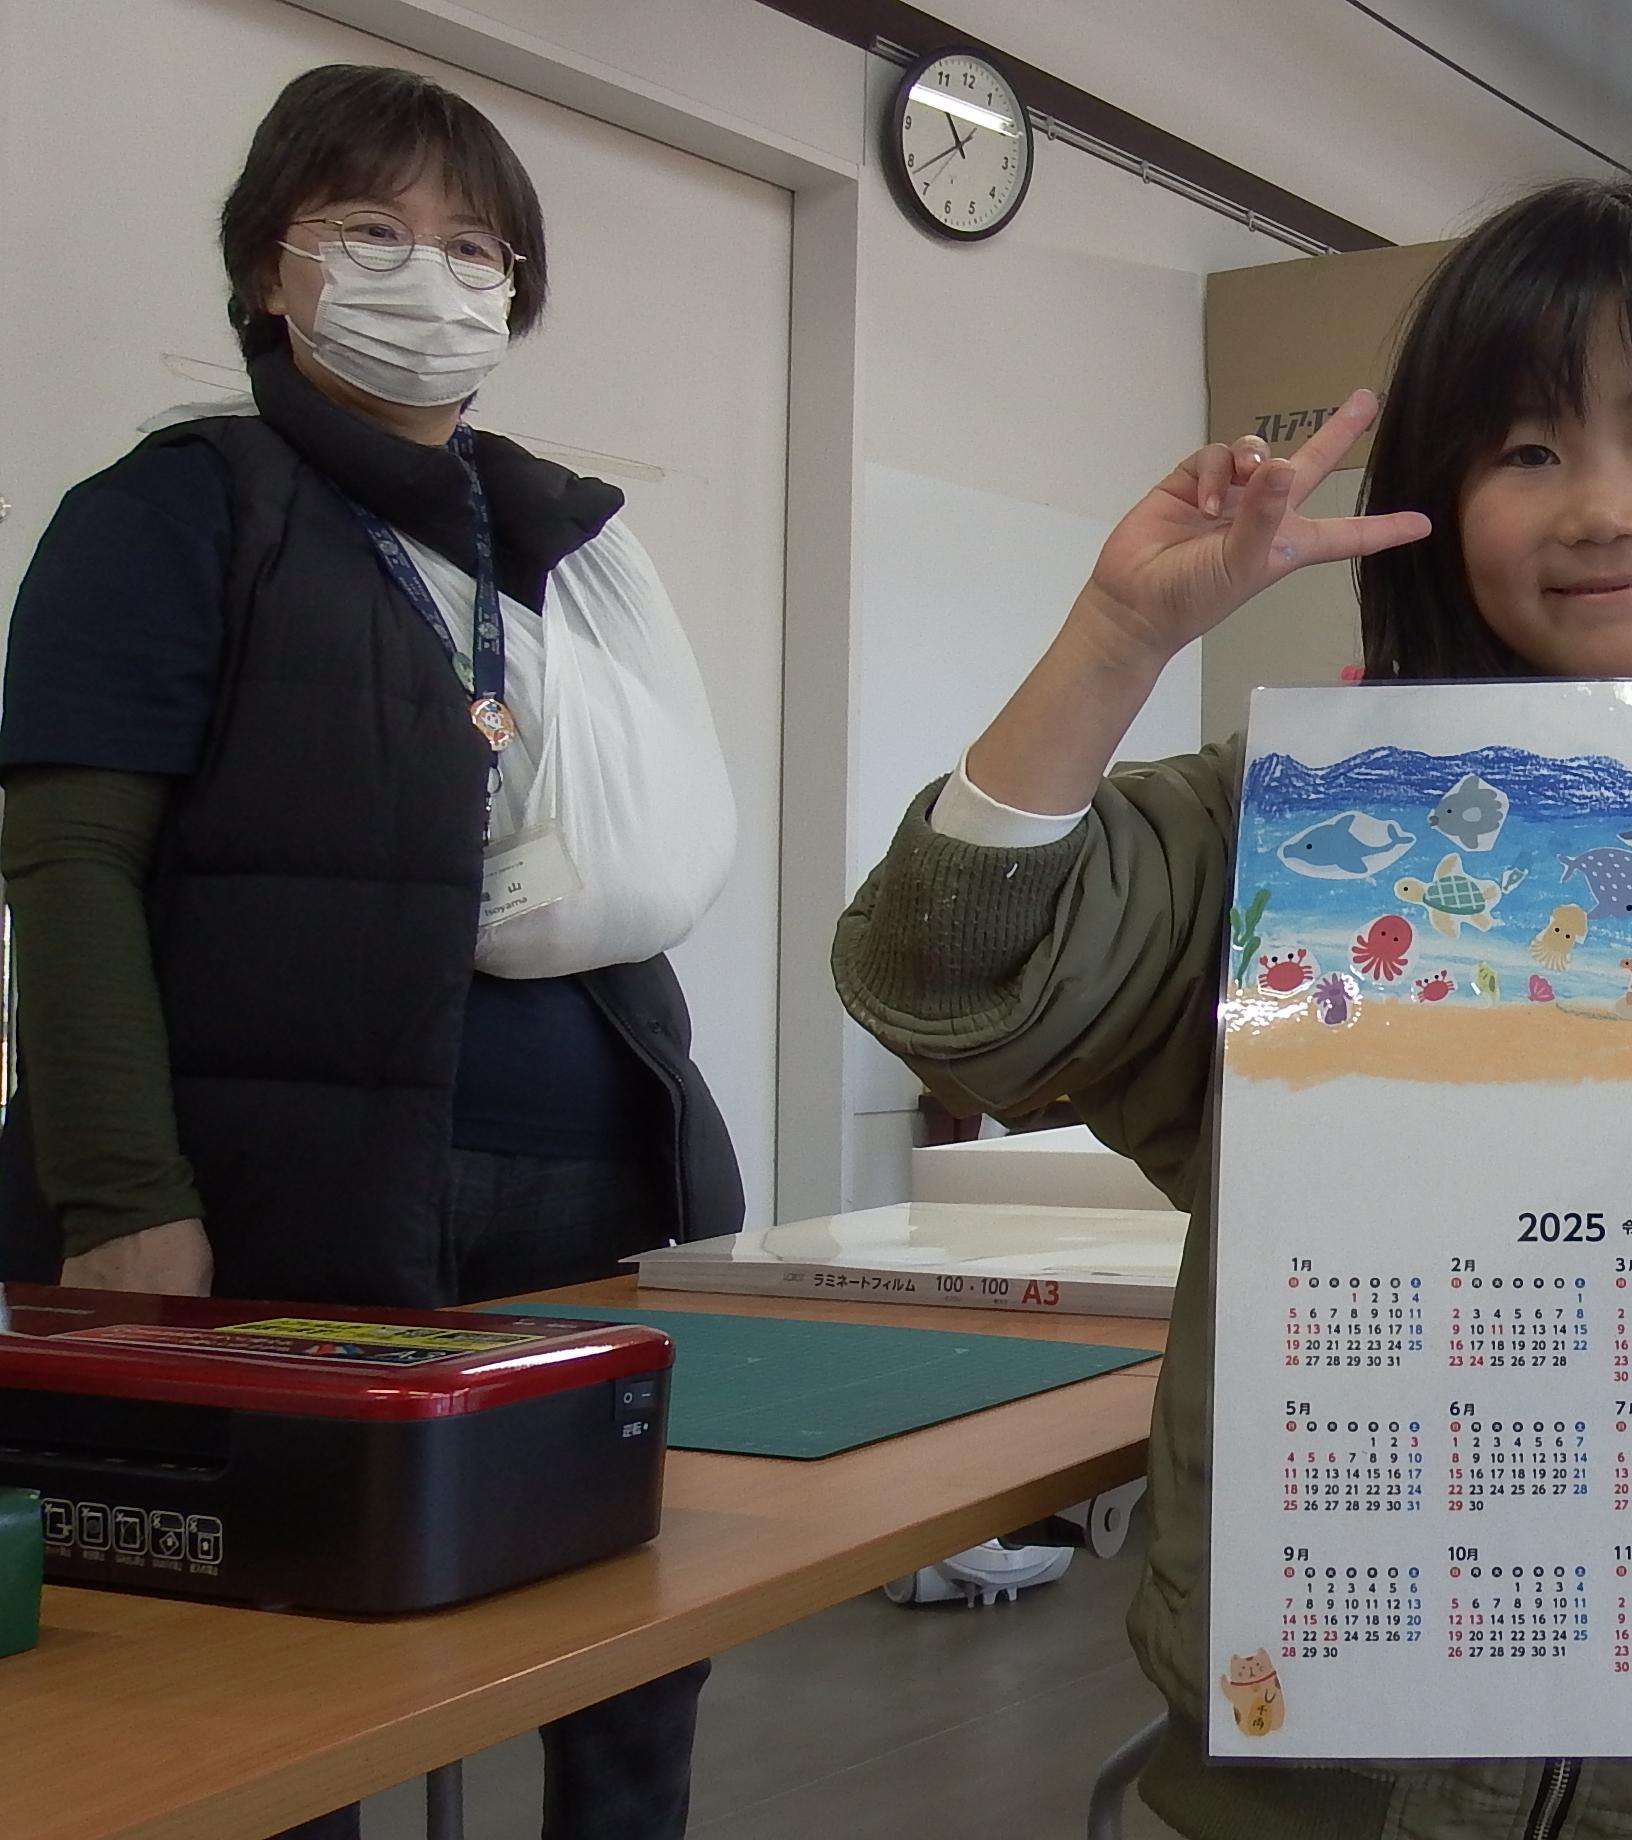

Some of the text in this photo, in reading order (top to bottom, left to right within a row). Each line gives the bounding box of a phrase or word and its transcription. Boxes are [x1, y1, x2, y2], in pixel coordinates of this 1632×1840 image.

[937, 71, 951, 88] 11
[962, 72, 976, 89] 12
[986, 93, 994, 106] 1
[904, 116, 912, 130] 9
[907, 153, 915, 168] 8
[1001, 156, 1010, 170] 3
[922, 182, 931, 196] 7
[944, 200, 952, 214] 6
[968, 200, 976, 215] 5
[1517, 1213, 1605, 1242] 2025
[1292, 1257, 1311, 1271] 1月
[1451, 1258, 1475, 1272] 2月
[813, 1273, 916, 1292] ラミネートフィルム
[936, 1276, 964, 1293] 100
[981, 1278, 1009, 1296] 100
[1022, 1280, 1060, 1306] A3
[1351, 1293, 1420, 1303] 1 2 3 4
[1577, 1293, 1583, 1303] 1
[1287, 1324, 1422, 1335] 12 13 14 15 16 17 18
[1450, 1340, 1587, 1350] 16 17 18 19 20 21 22
[1614, 1356, 1628, 1366] 23
[1614, 1371, 1628, 1382] 30
[1286, 1401, 1310, 1415] 5月
[1450, 1401, 1474, 1416] 6月
[1370, 1437, 1419, 1447] 1 2 3
[1450, 1468, 1585, 1479] 15 16 17 18 19 20 21
[1285, 1484, 1421, 1495] 18 19 20 21 22 23 24
[1614, 1484, 1628, 1494] 20
[1449, 1500, 1483, 1511] 29 30
[1284, 1546, 1308, 1561] 9月
[1448, 1547, 1477, 1561] 10月
[1515, 1582, 1584, 1592] 1 2 3 4
[1285, 1598, 1421, 1609] 7 8 9 10 11 12 13
[1617, 1613, 1626, 1624] 9
[1449, 1630, 1587, 1641] 19 20 21 22 23 24 25
[1282, 1647, 1337, 1657] 28 29 30
[1615, 1662, 1629, 1672] 30
